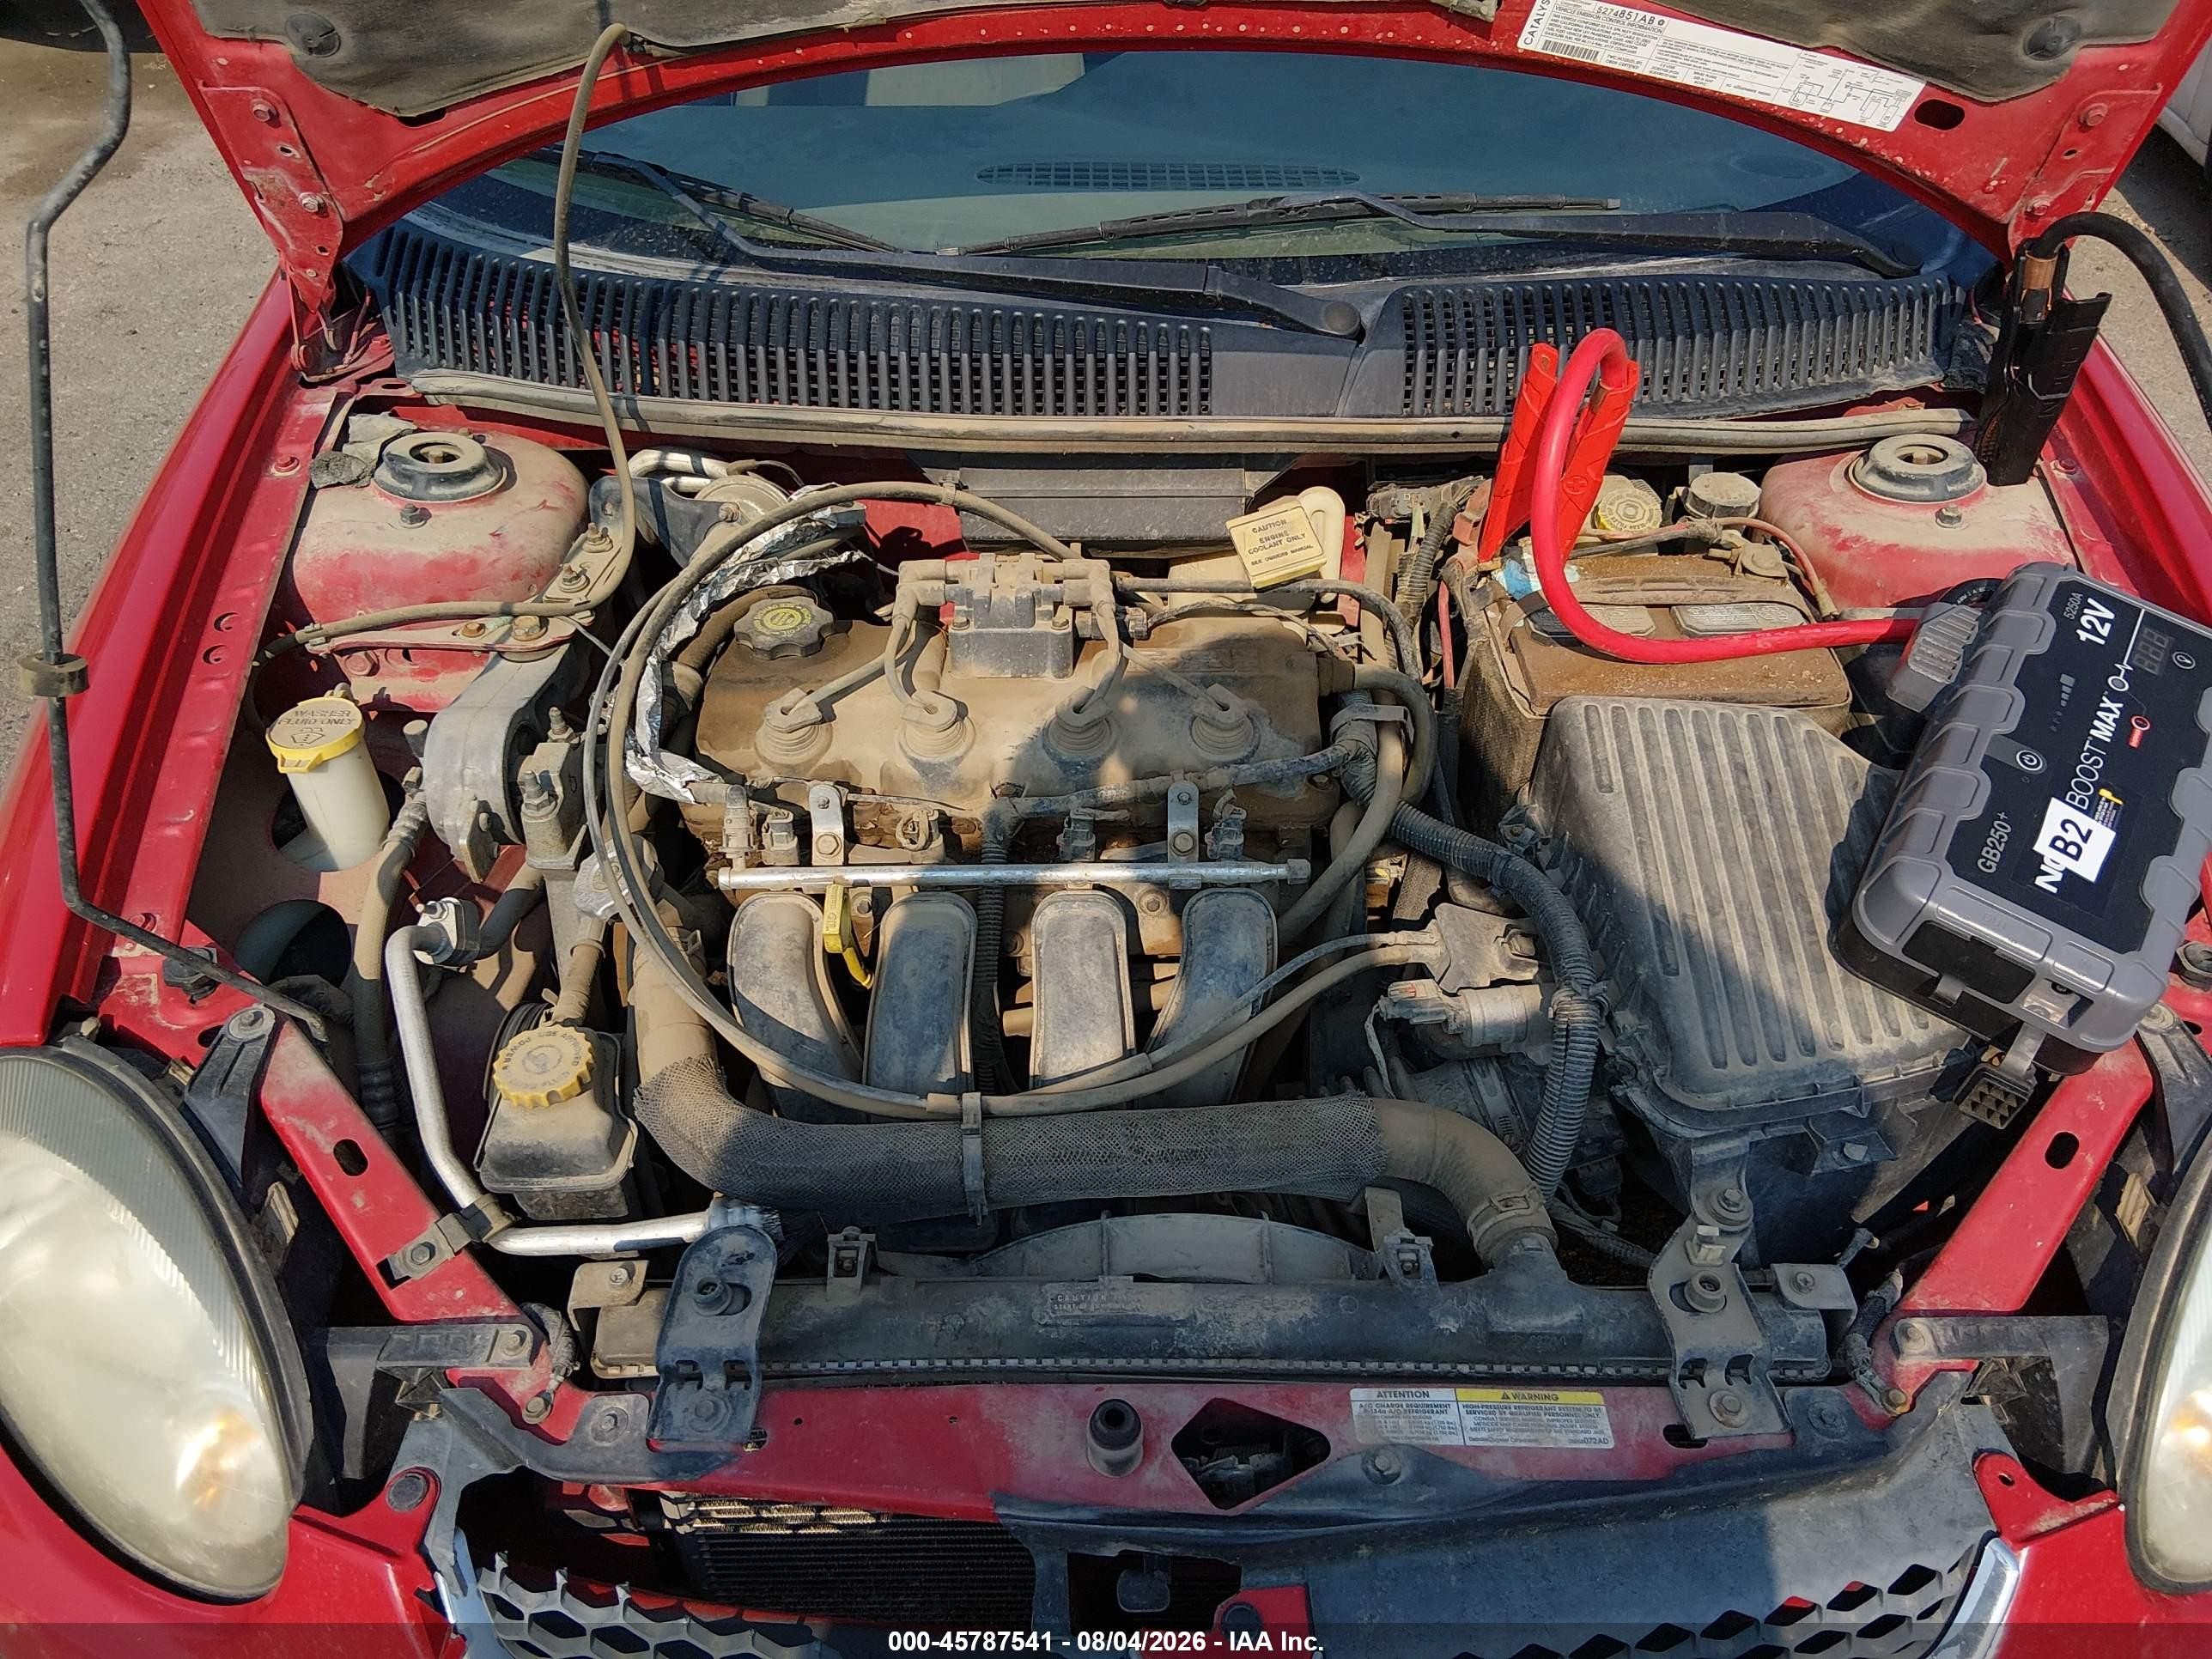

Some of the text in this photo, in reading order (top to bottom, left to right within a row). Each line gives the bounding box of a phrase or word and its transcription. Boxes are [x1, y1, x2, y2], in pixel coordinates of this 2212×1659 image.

[1554, 6, 1663, 34] VEHICLE EMISSION CONTROL INFORMATION
[1595, 5, 1656, 26] 5274851AB
[1252, 519, 1287, 533] CAUTION
[1259, 530, 1289, 544] ENGINE
[1248, 533, 1306, 555] COOLANT ONLY
[2063, 592, 2083, 620] 5250A
[2075, 598, 2115, 645] 12V
[2065, 739, 2106, 810] BOOST
[1977, 811, 2012, 873] GB250+
[2048, 818, 2093, 862] B2
[1376, 1390, 1430, 1399] ATTENTION
[1511, 1392, 1559, 1401] WARNING
